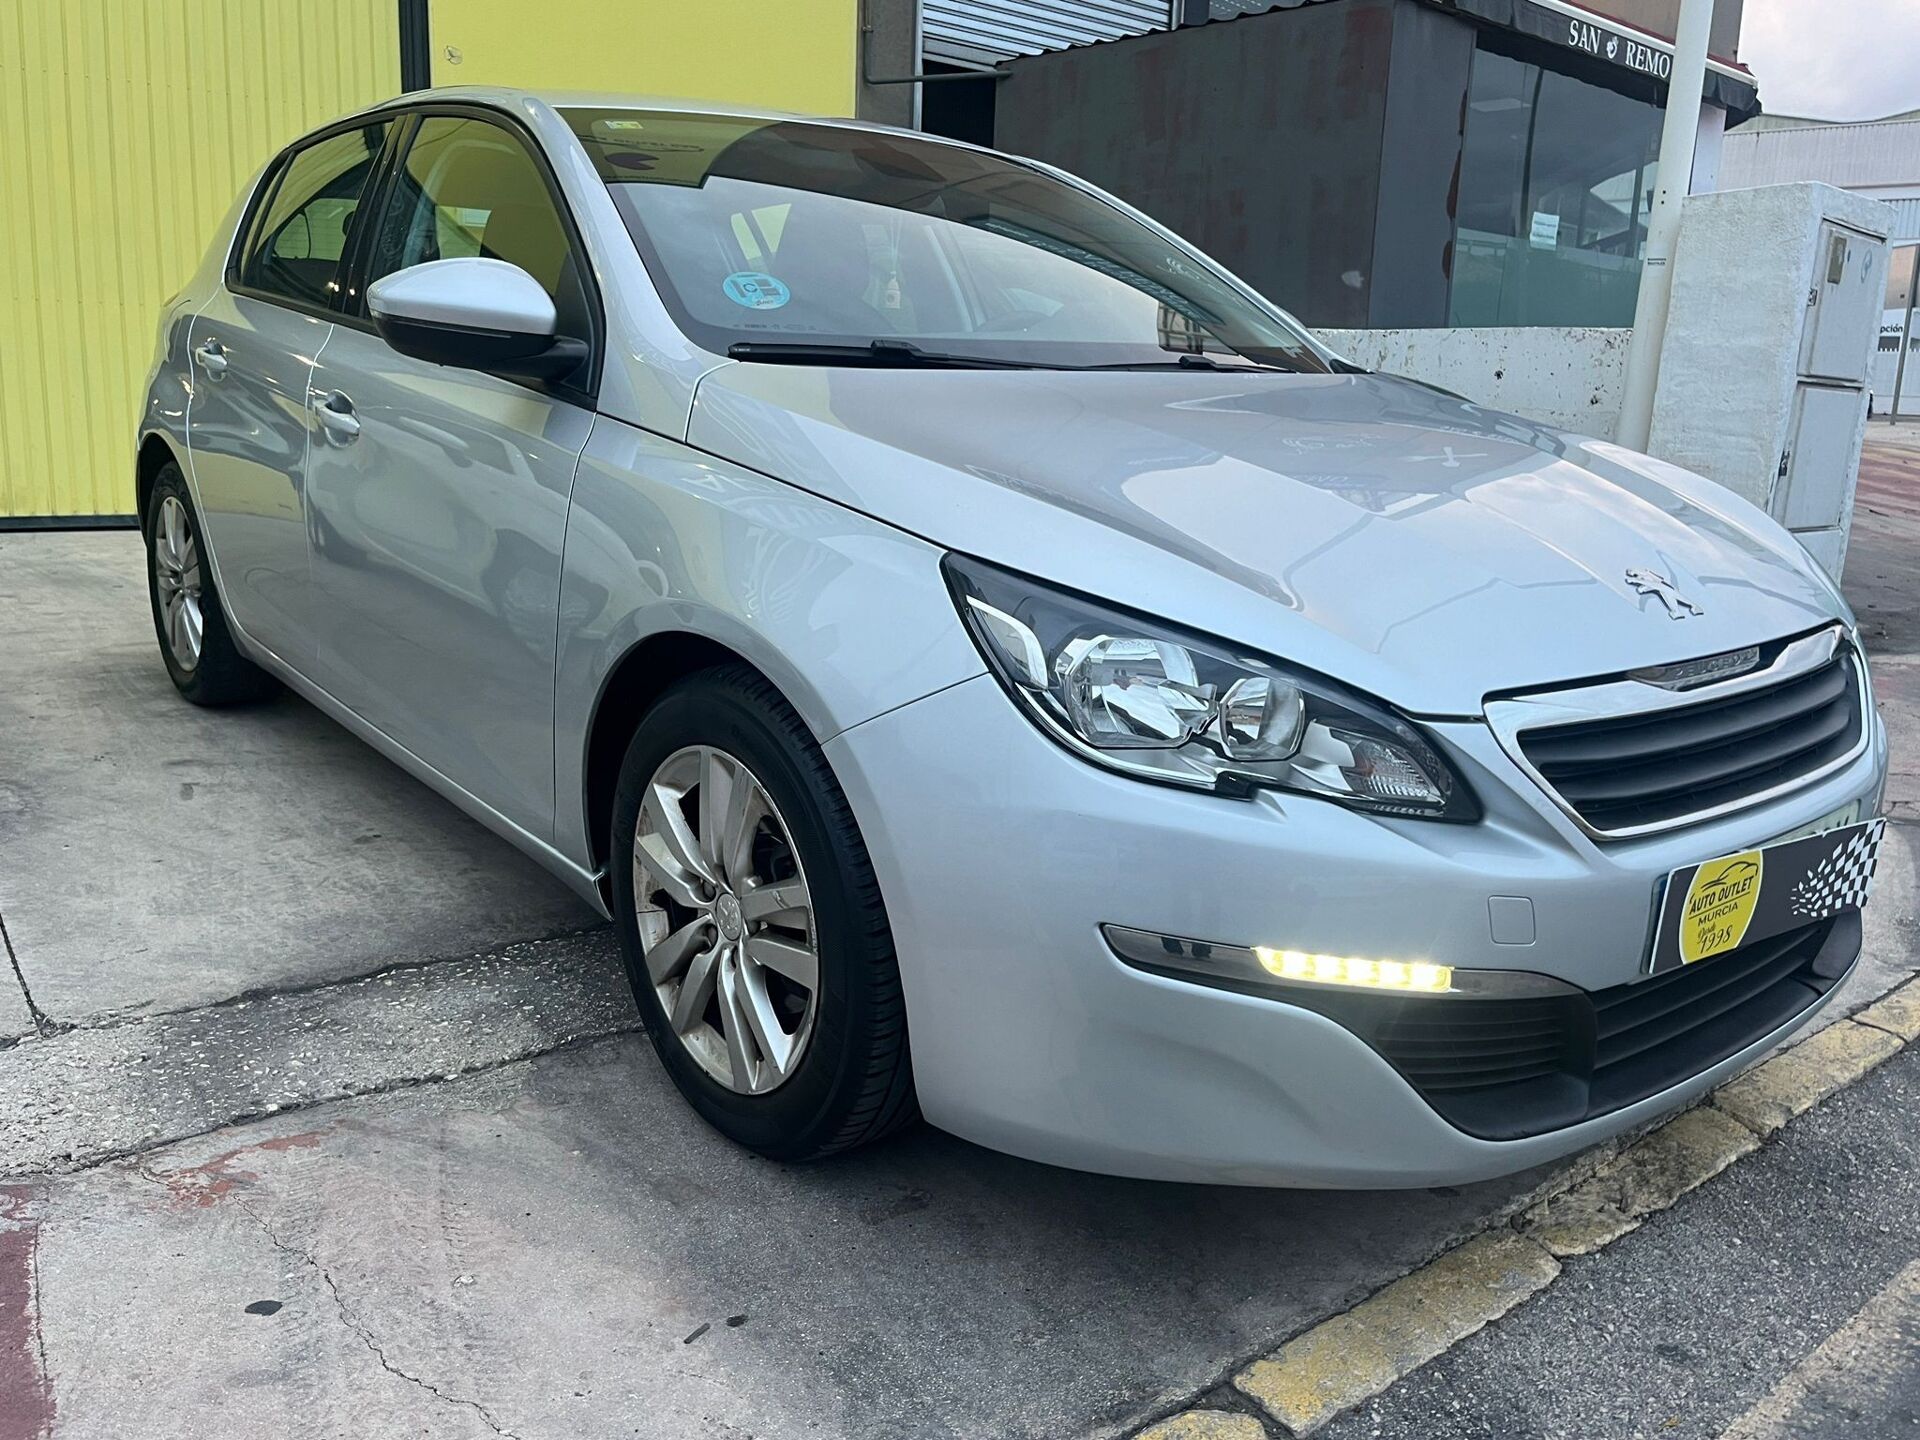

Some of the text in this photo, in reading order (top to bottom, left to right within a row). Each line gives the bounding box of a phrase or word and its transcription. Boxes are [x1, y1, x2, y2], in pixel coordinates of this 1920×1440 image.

[1568, 20, 1670, 78] SAN REMO
[1689, 876, 1754, 915] AUTO OUTLET
[1698, 902, 1738, 927] MURCIA
[1700, 925, 1733, 954] 1998
